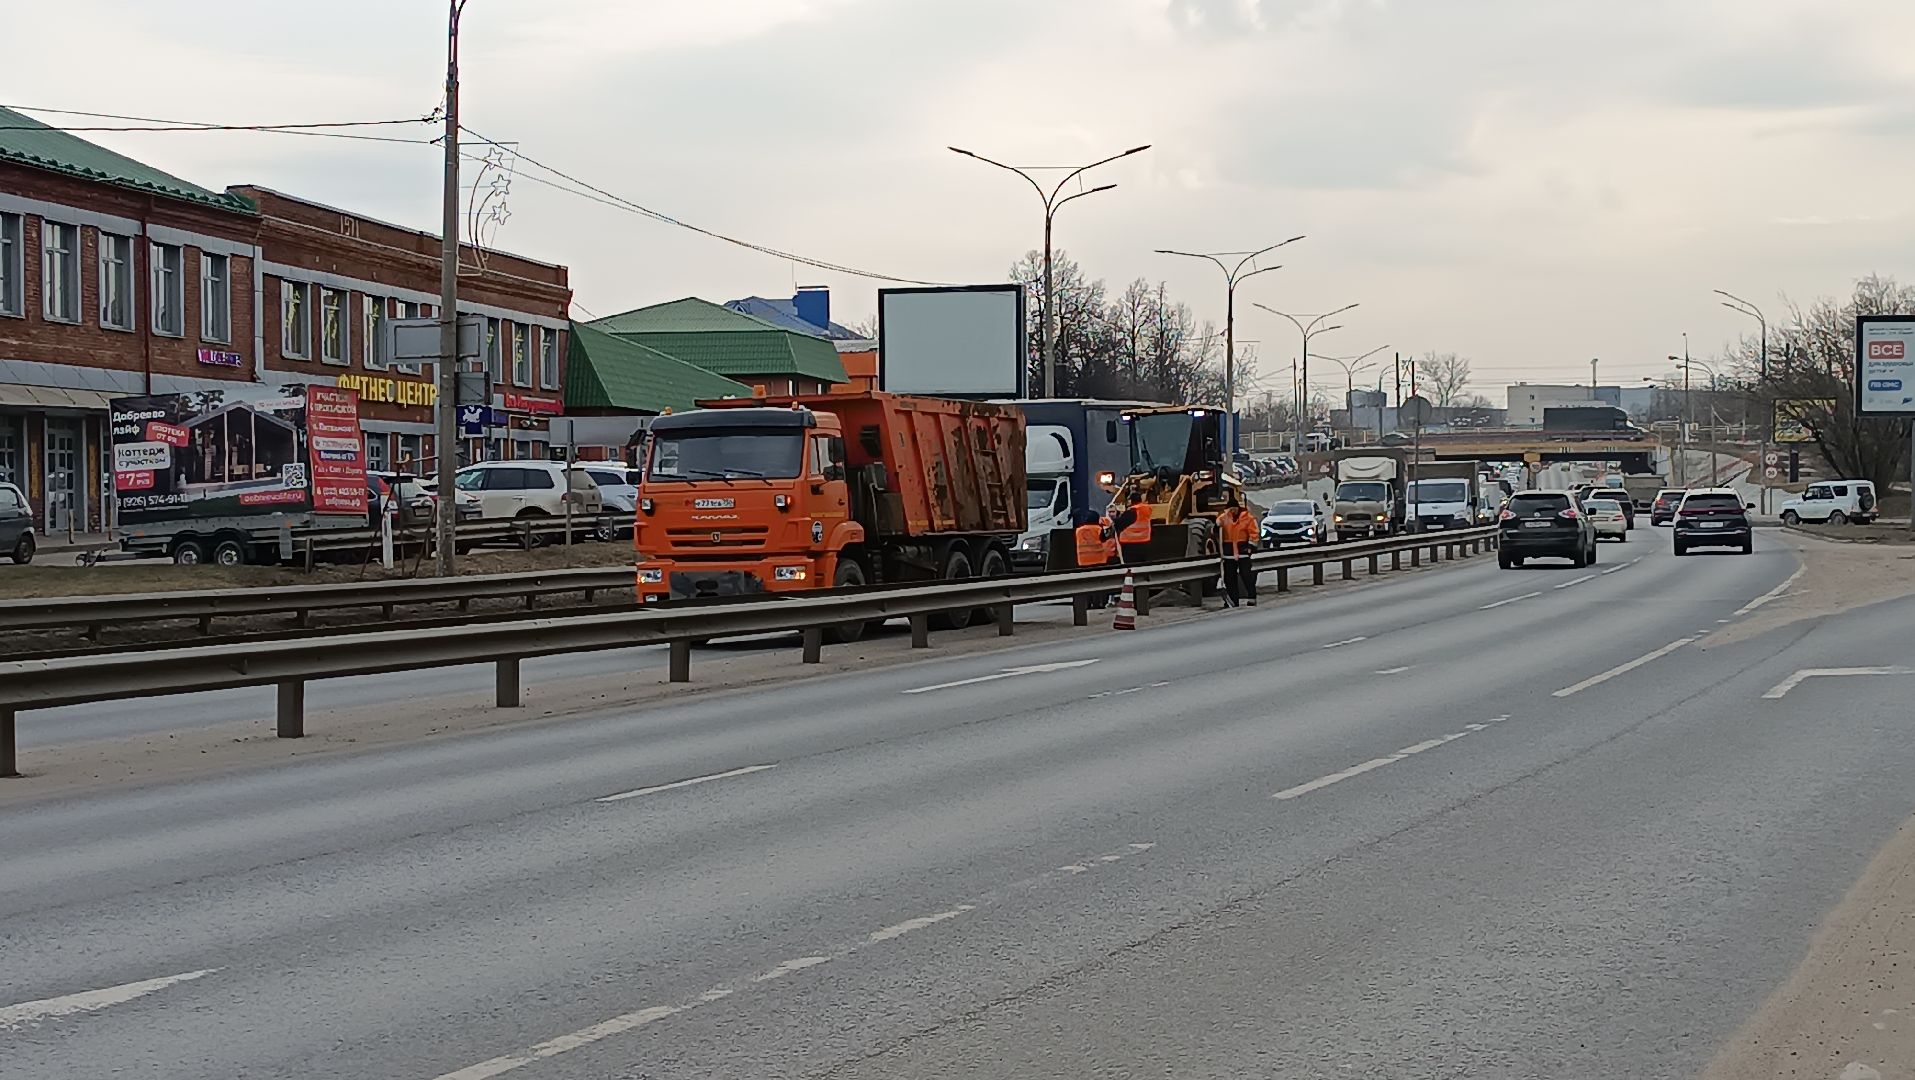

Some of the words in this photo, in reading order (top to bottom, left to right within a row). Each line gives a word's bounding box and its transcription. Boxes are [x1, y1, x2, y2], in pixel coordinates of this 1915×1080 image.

[1871, 344, 1903, 356] ВСЕ
[338, 373, 394, 402] ФИТНЕС
[397, 380, 437, 408] ЦЕНТР
[125, 472, 136, 486] 7
